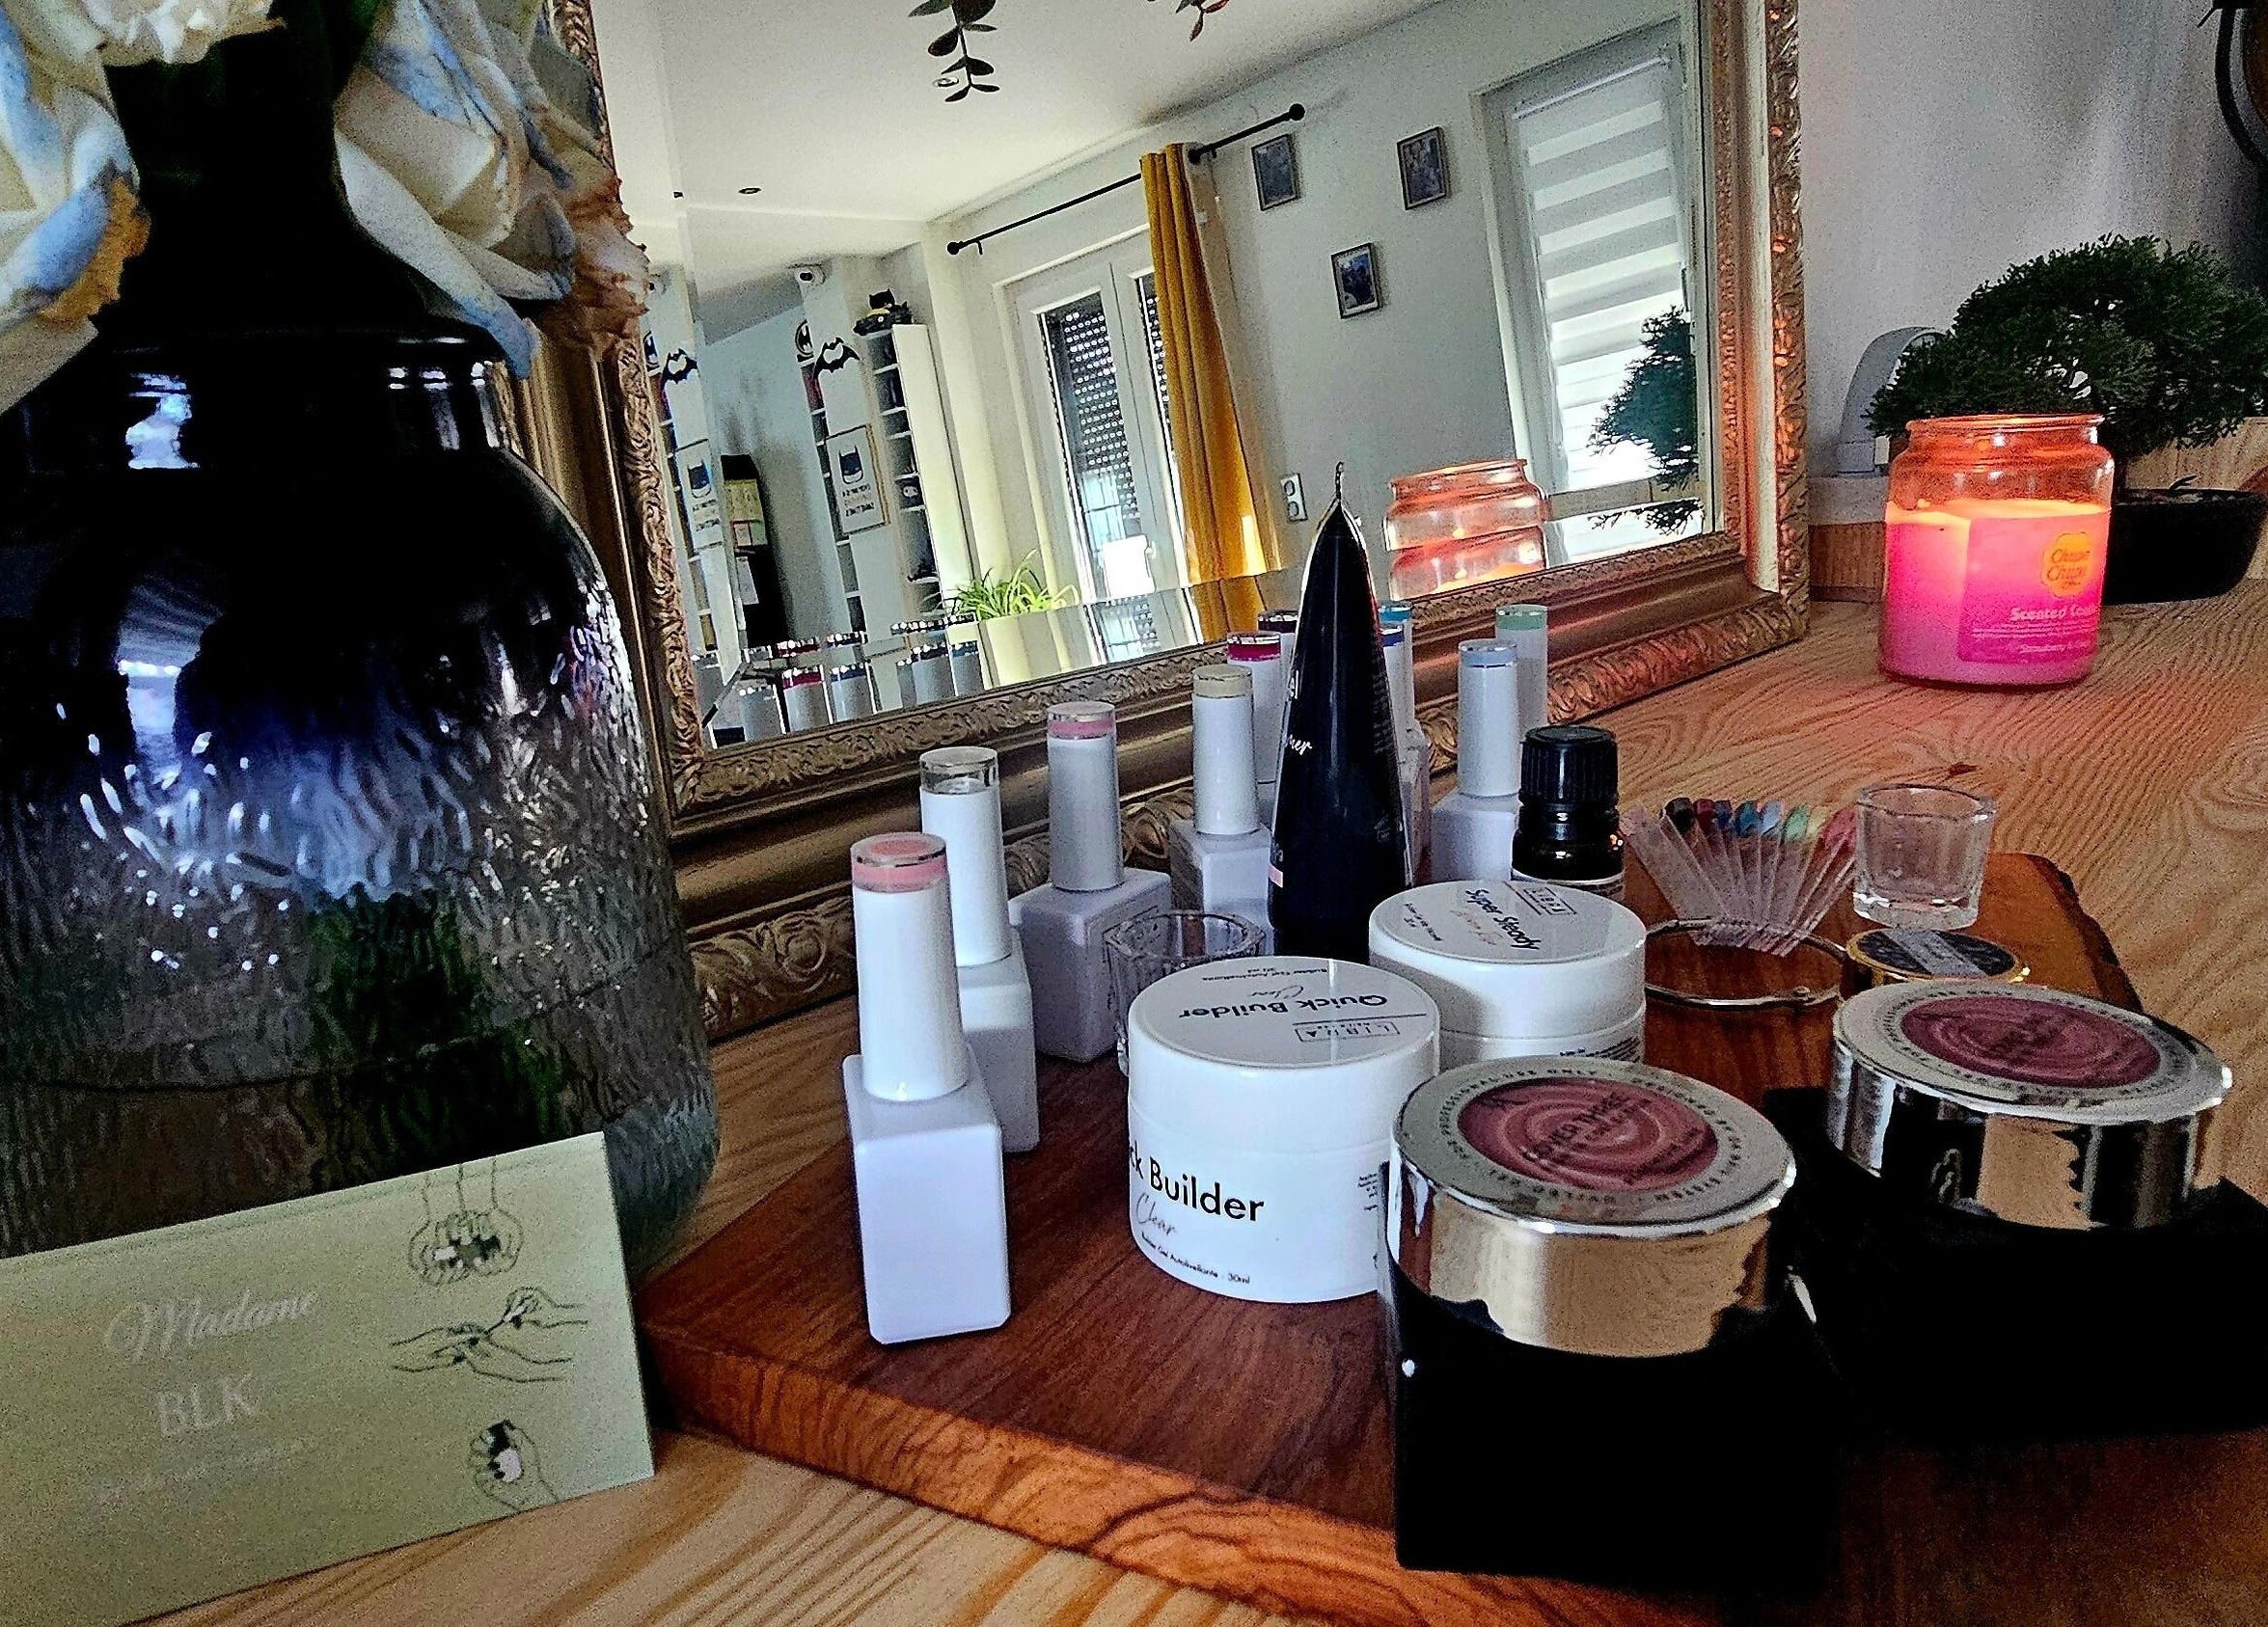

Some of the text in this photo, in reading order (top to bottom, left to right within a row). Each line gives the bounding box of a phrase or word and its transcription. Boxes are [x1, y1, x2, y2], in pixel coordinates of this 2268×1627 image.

[1465, 888, 1503, 915] Super
[1493, 914, 1542, 951] Steady
[1177, 994, 1388, 1019] Quick Builder
[1136, 1191, 1176, 1234] Clear
[1149, 1156, 1266, 1222] Builder
[104, 1288, 319, 1365] Madame
[156, 1372, 260, 1439] BLK
